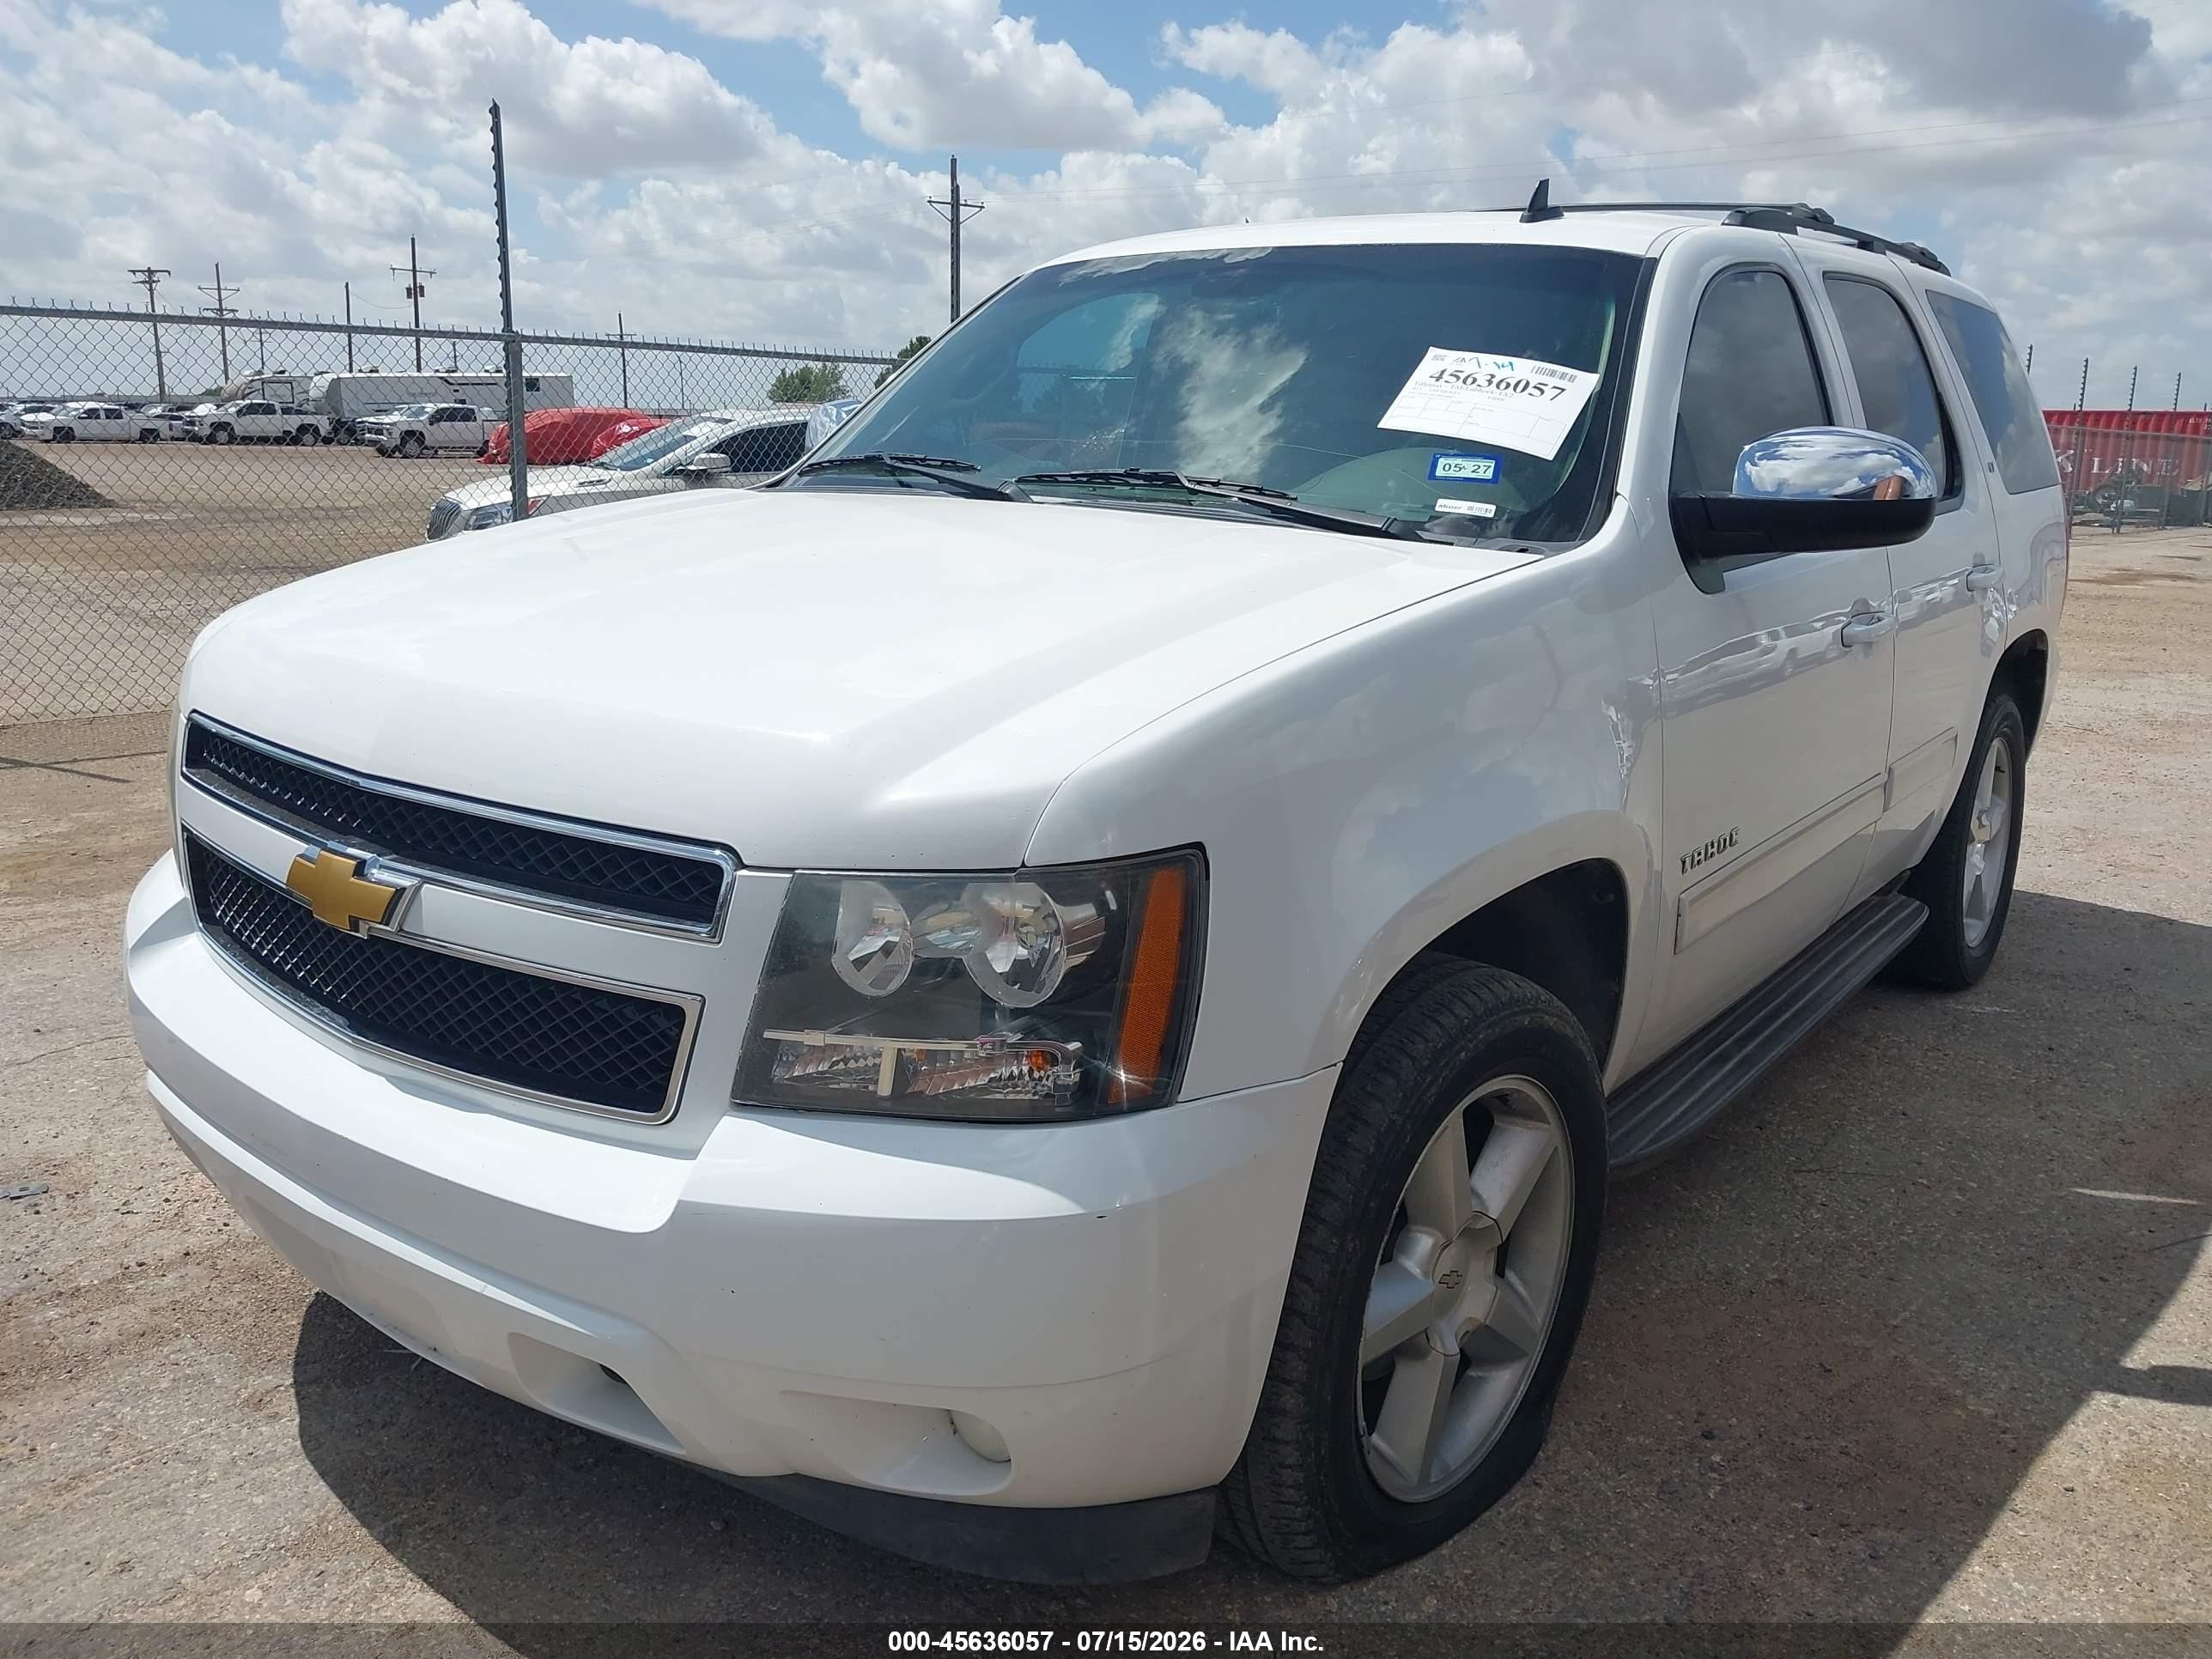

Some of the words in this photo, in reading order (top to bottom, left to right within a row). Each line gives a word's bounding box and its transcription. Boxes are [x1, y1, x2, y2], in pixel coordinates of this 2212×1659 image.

[1429, 368, 1566, 401] 45636057
[1470, 465, 1492, 474] 27
[1680, 825, 1740, 875] TAHOE
